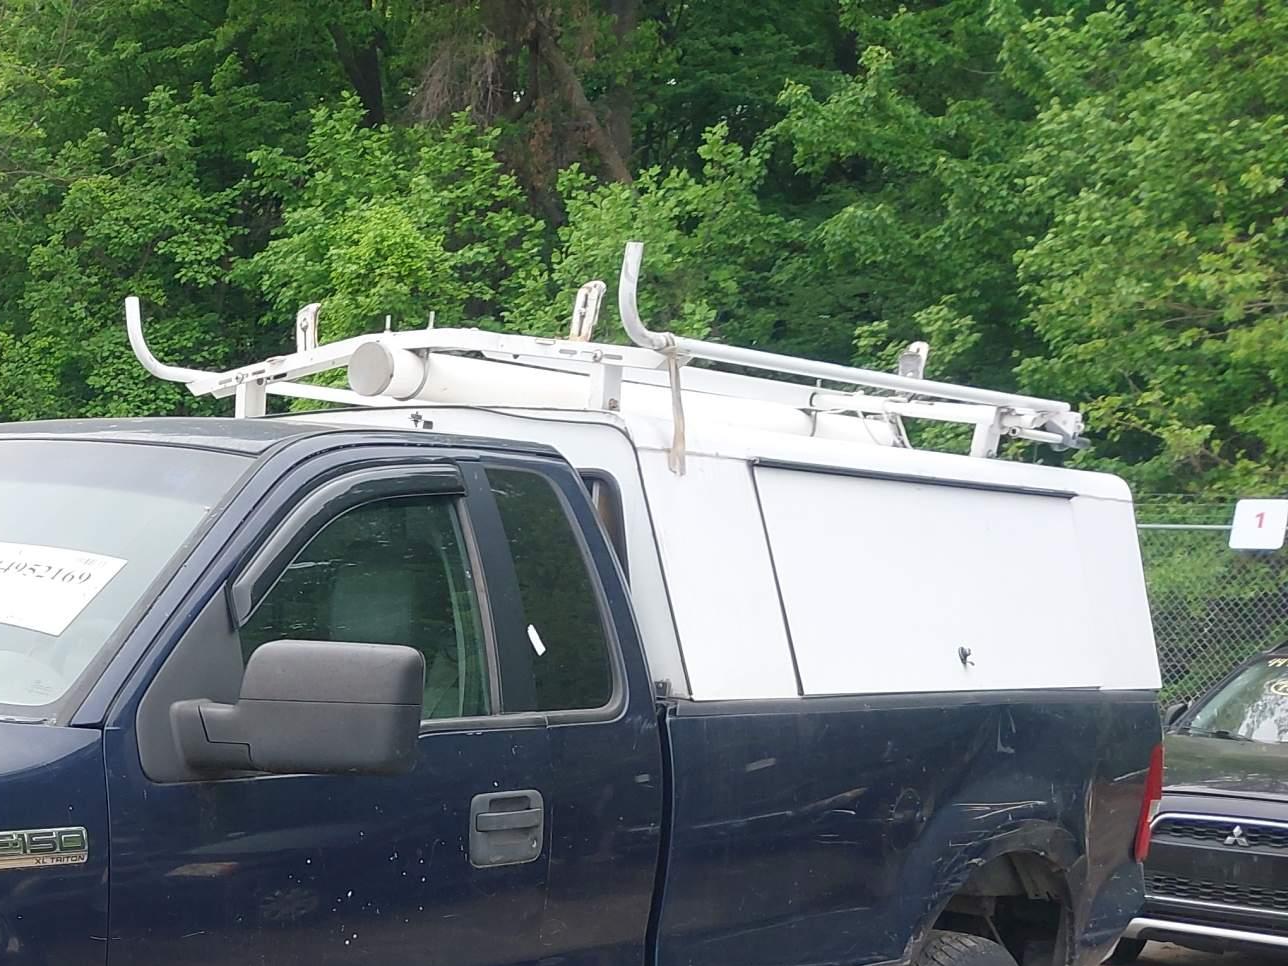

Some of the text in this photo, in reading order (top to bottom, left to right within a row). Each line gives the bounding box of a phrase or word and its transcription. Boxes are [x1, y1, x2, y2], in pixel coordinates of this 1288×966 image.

[1255, 511, 1266, 529] 1
[34, 855, 85, 865] XL TRITON
